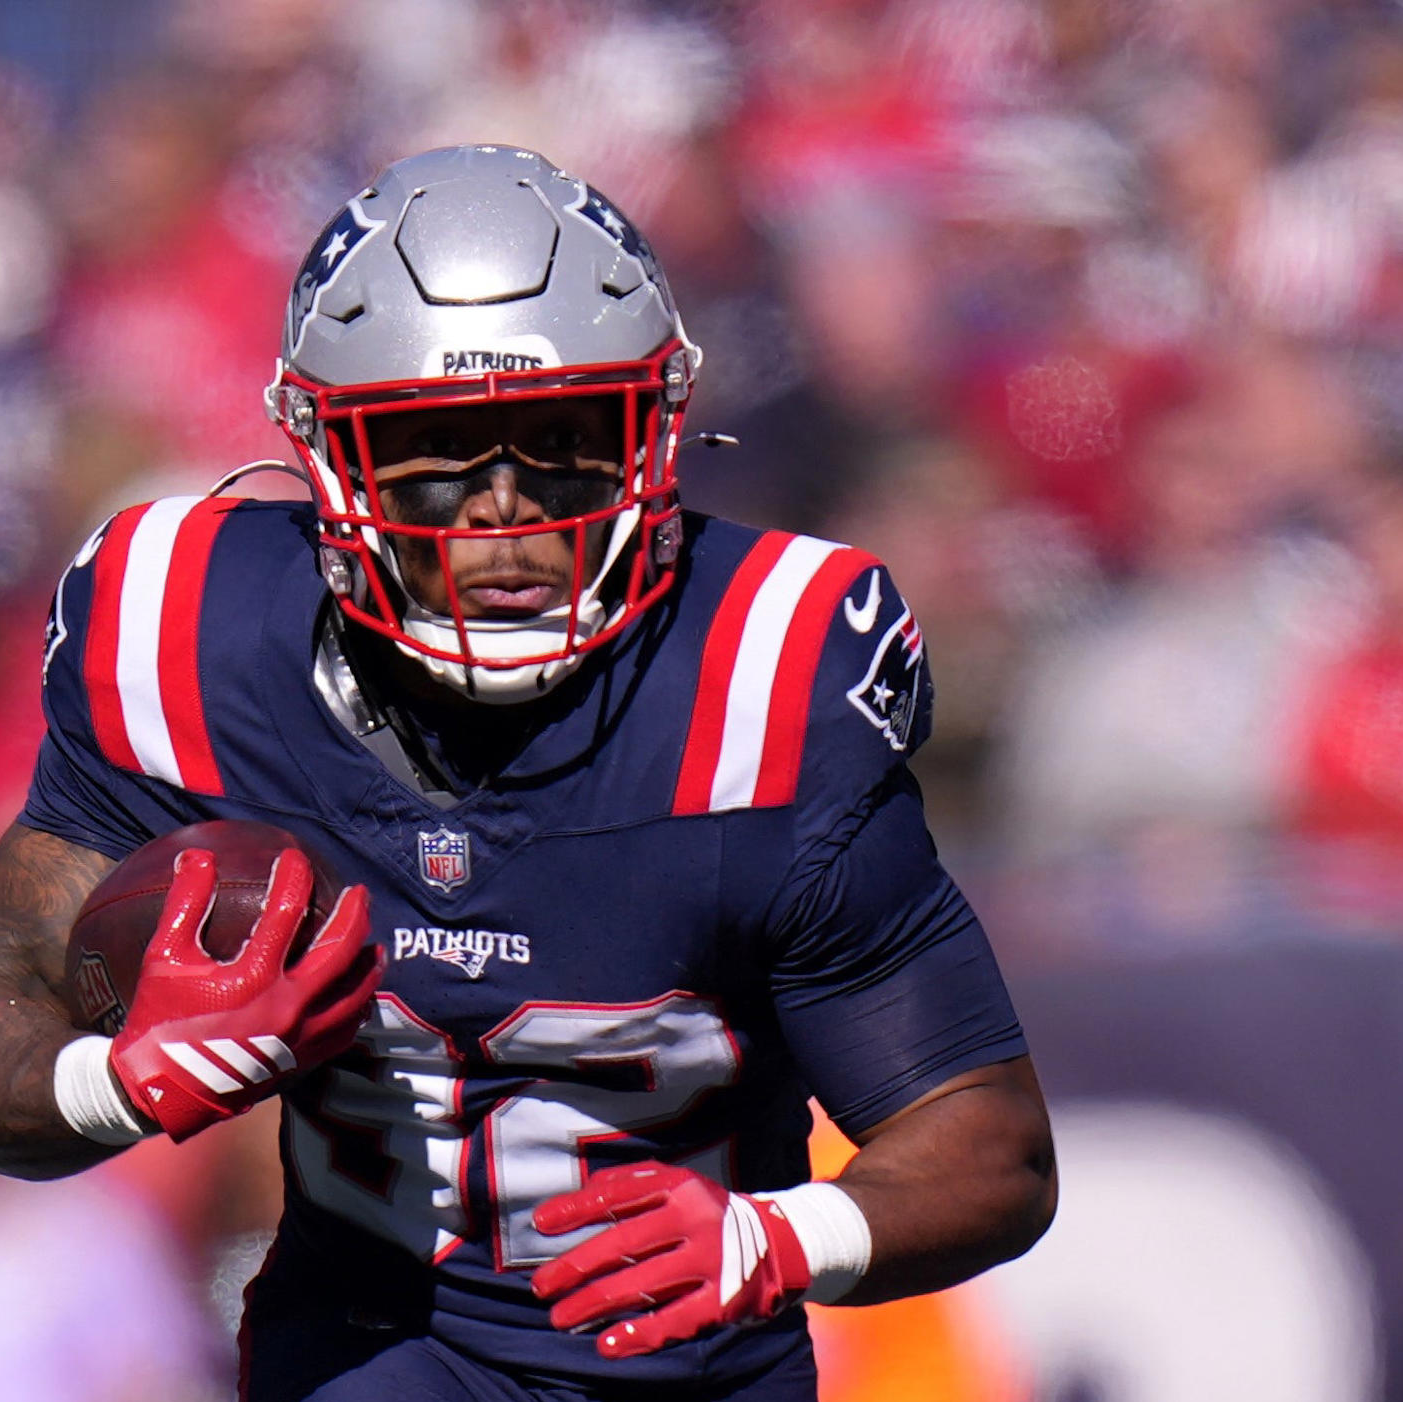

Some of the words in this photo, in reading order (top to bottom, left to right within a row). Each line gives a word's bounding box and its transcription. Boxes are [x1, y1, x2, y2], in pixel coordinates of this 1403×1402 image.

[443, 350, 544, 376] PATRIOTS
[428, 857, 462, 880] NFL
[394, 928, 530, 963] PATRIOTS
